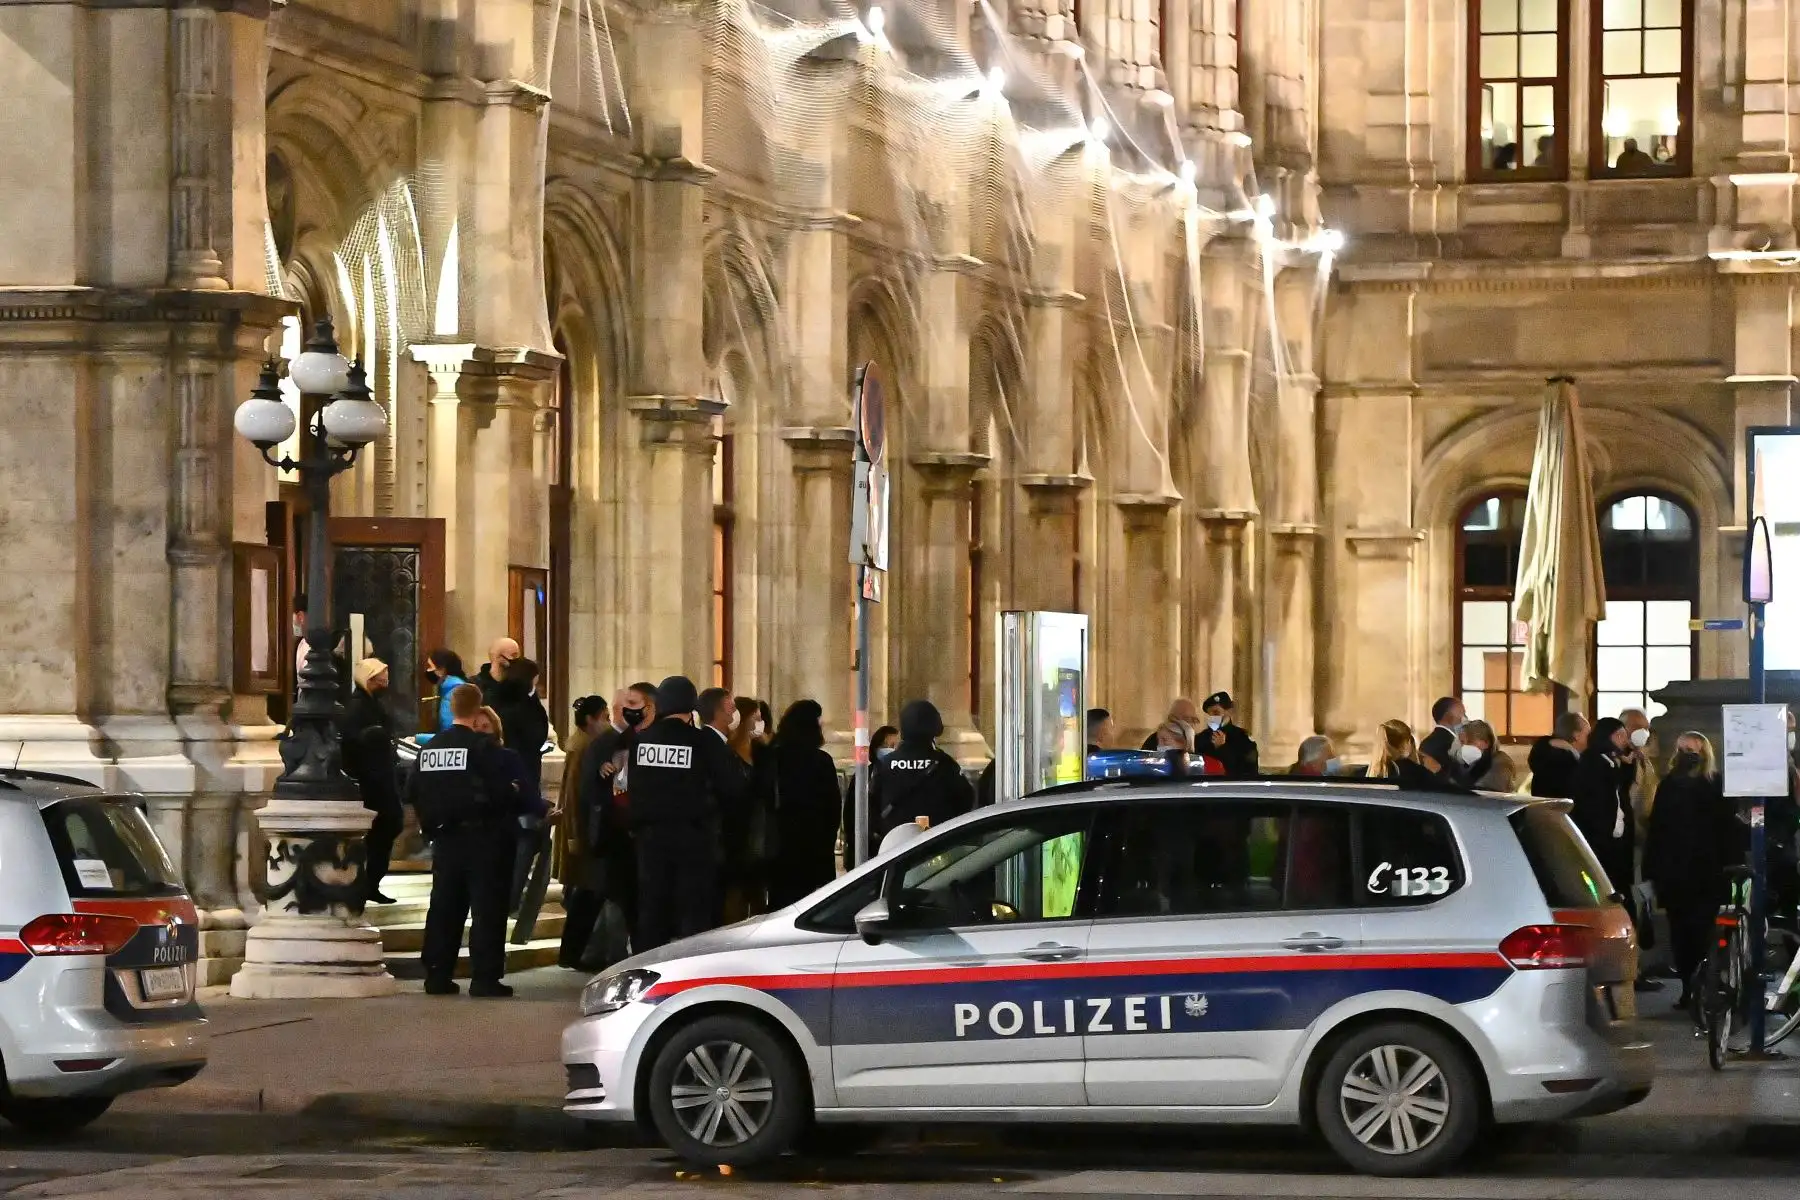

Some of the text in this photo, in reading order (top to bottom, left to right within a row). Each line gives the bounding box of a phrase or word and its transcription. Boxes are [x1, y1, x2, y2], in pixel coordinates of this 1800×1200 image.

[421, 750, 466, 769] POLIZEI
[638, 746, 690, 766] POLIZEI
[890, 759, 936, 770] POLIZE
[1395, 866, 1450, 896] 133
[153, 945, 187, 963] POLIZEI
[953, 995, 1172, 1037] POLIZEI
